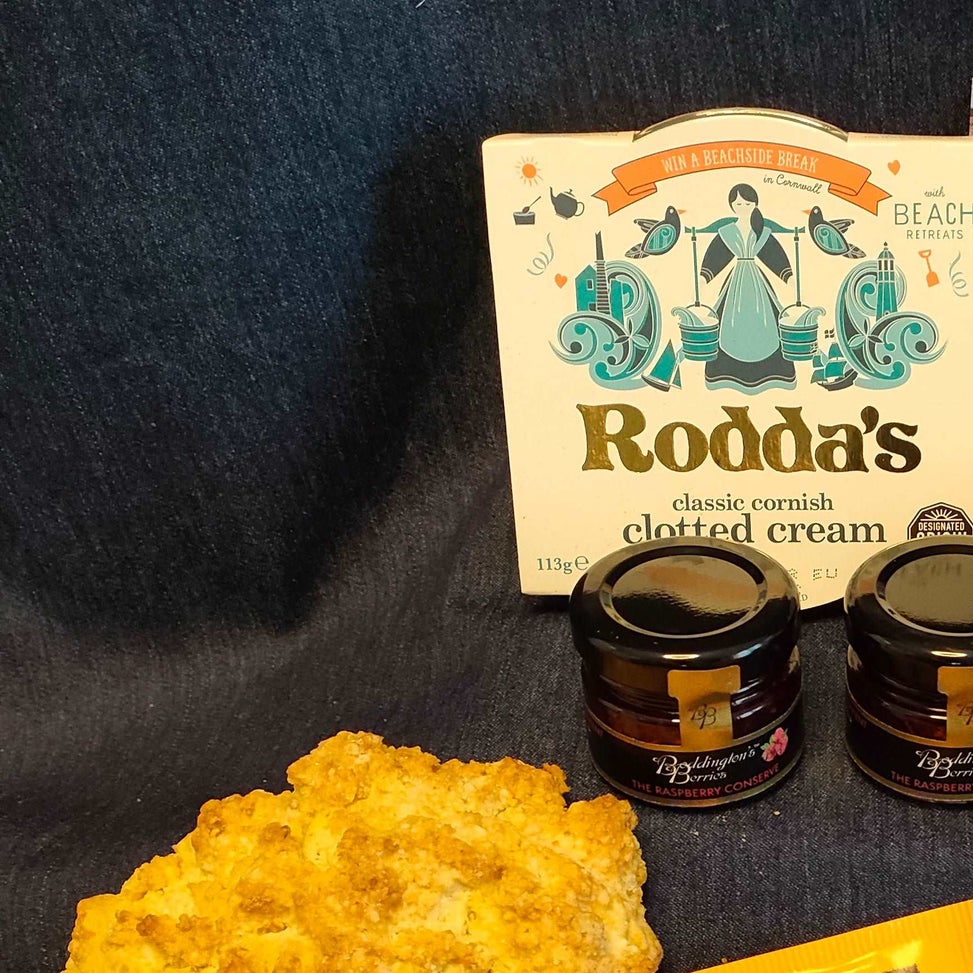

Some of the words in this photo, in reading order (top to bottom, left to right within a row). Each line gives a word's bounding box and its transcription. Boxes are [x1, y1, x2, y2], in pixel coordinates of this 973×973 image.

[661, 155, 688, 173] WIN
[690, 154, 699, 167] A
[703, 148, 774, 165] BEACHSIDE
[777, 150, 820, 173] BREAK
[763, 174, 774, 185] in
[776, 173, 823, 195] Cornwall
[924, 187, 946, 198] with
[906, 229, 964, 240] RETREATS
[576, 402, 922, 473] Rodda's
[672, 493, 744, 511] classic
[751, 492, 834, 511] cornish
[622, 513, 755, 544] clotted
[767, 520, 887, 544] cream
[918, 521, 965, 531] DESIGNATED
[813, 568, 837, 580] EU
[632, 779, 652, 793] THE
[655, 786, 721, 797] RASPBERRY
[724, 764, 779, 793] CONSERVE
[668, 764, 727, 784] Berries
[891, 771, 911, 786] THE
